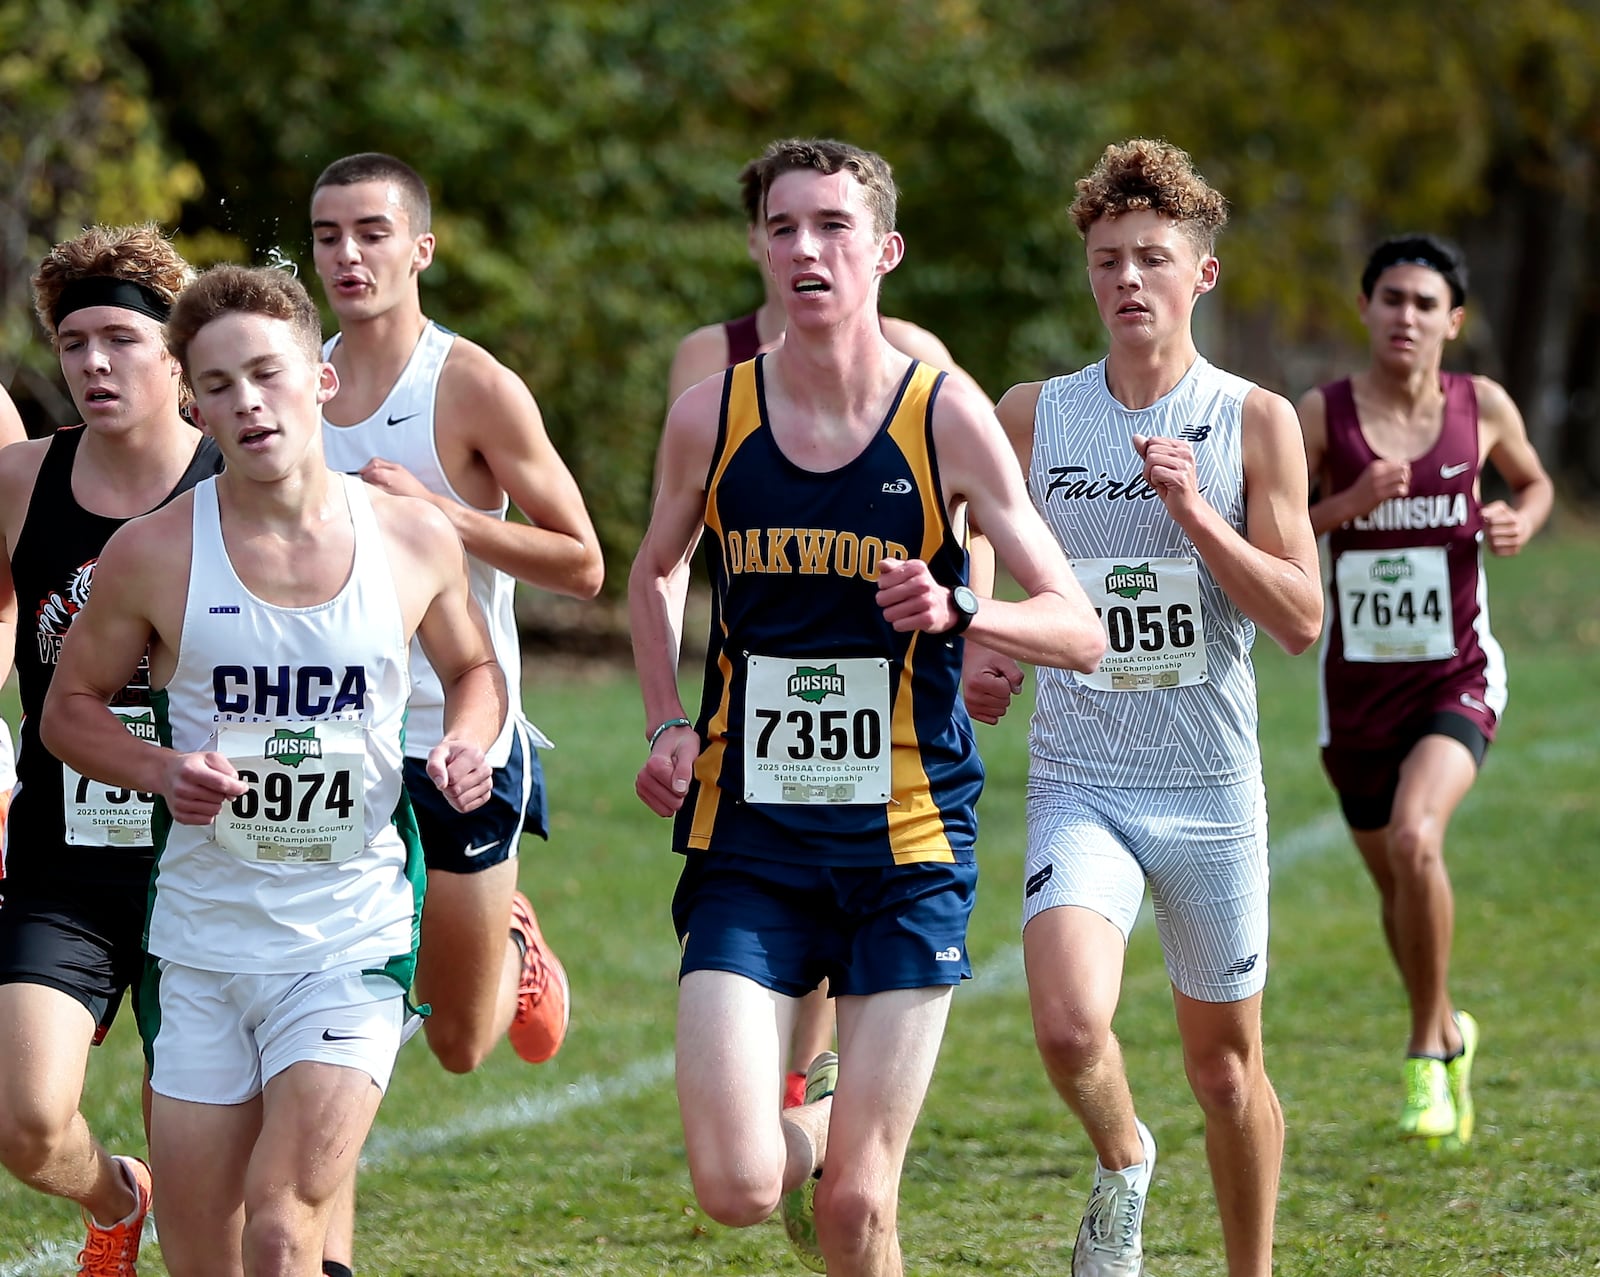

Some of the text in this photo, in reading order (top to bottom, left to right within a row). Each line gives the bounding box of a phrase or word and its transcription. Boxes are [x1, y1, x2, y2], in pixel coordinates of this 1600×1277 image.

[882, 481, 906, 492] PCS
[1341, 493, 1467, 531] NINSULA
[1108, 573, 1156, 590] OHSAA
[1348, 589, 1442, 627] 7644
[1095, 604, 1195, 653] 056
[1105, 656, 1135, 664] OHSAA
[1137, 655, 1160, 663] Cross
[1163, 651, 1196, 660] Country
[1123, 662, 1182, 673] Championship
[790, 675, 842, 693] OHSAA
[213, 665, 367, 717] CHCA
[213, 713, 271, 723] CROS
[756, 708, 881, 761] 7350
[268, 737, 320, 755] OHSAA
[758, 763, 880, 773] 2025 OHSAA Cross Country
[774, 774, 863, 783] State Championship
[231, 770, 354, 822] 6974
[77, 808, 97, 816] 2025
[99, 808, 130, 816] OHSAA
[117, 818, 149, 826] Champi
[230, 822, 354, 834] 2025 OHSAA Cross Country
[246, 833, 337, 844] State Championship
